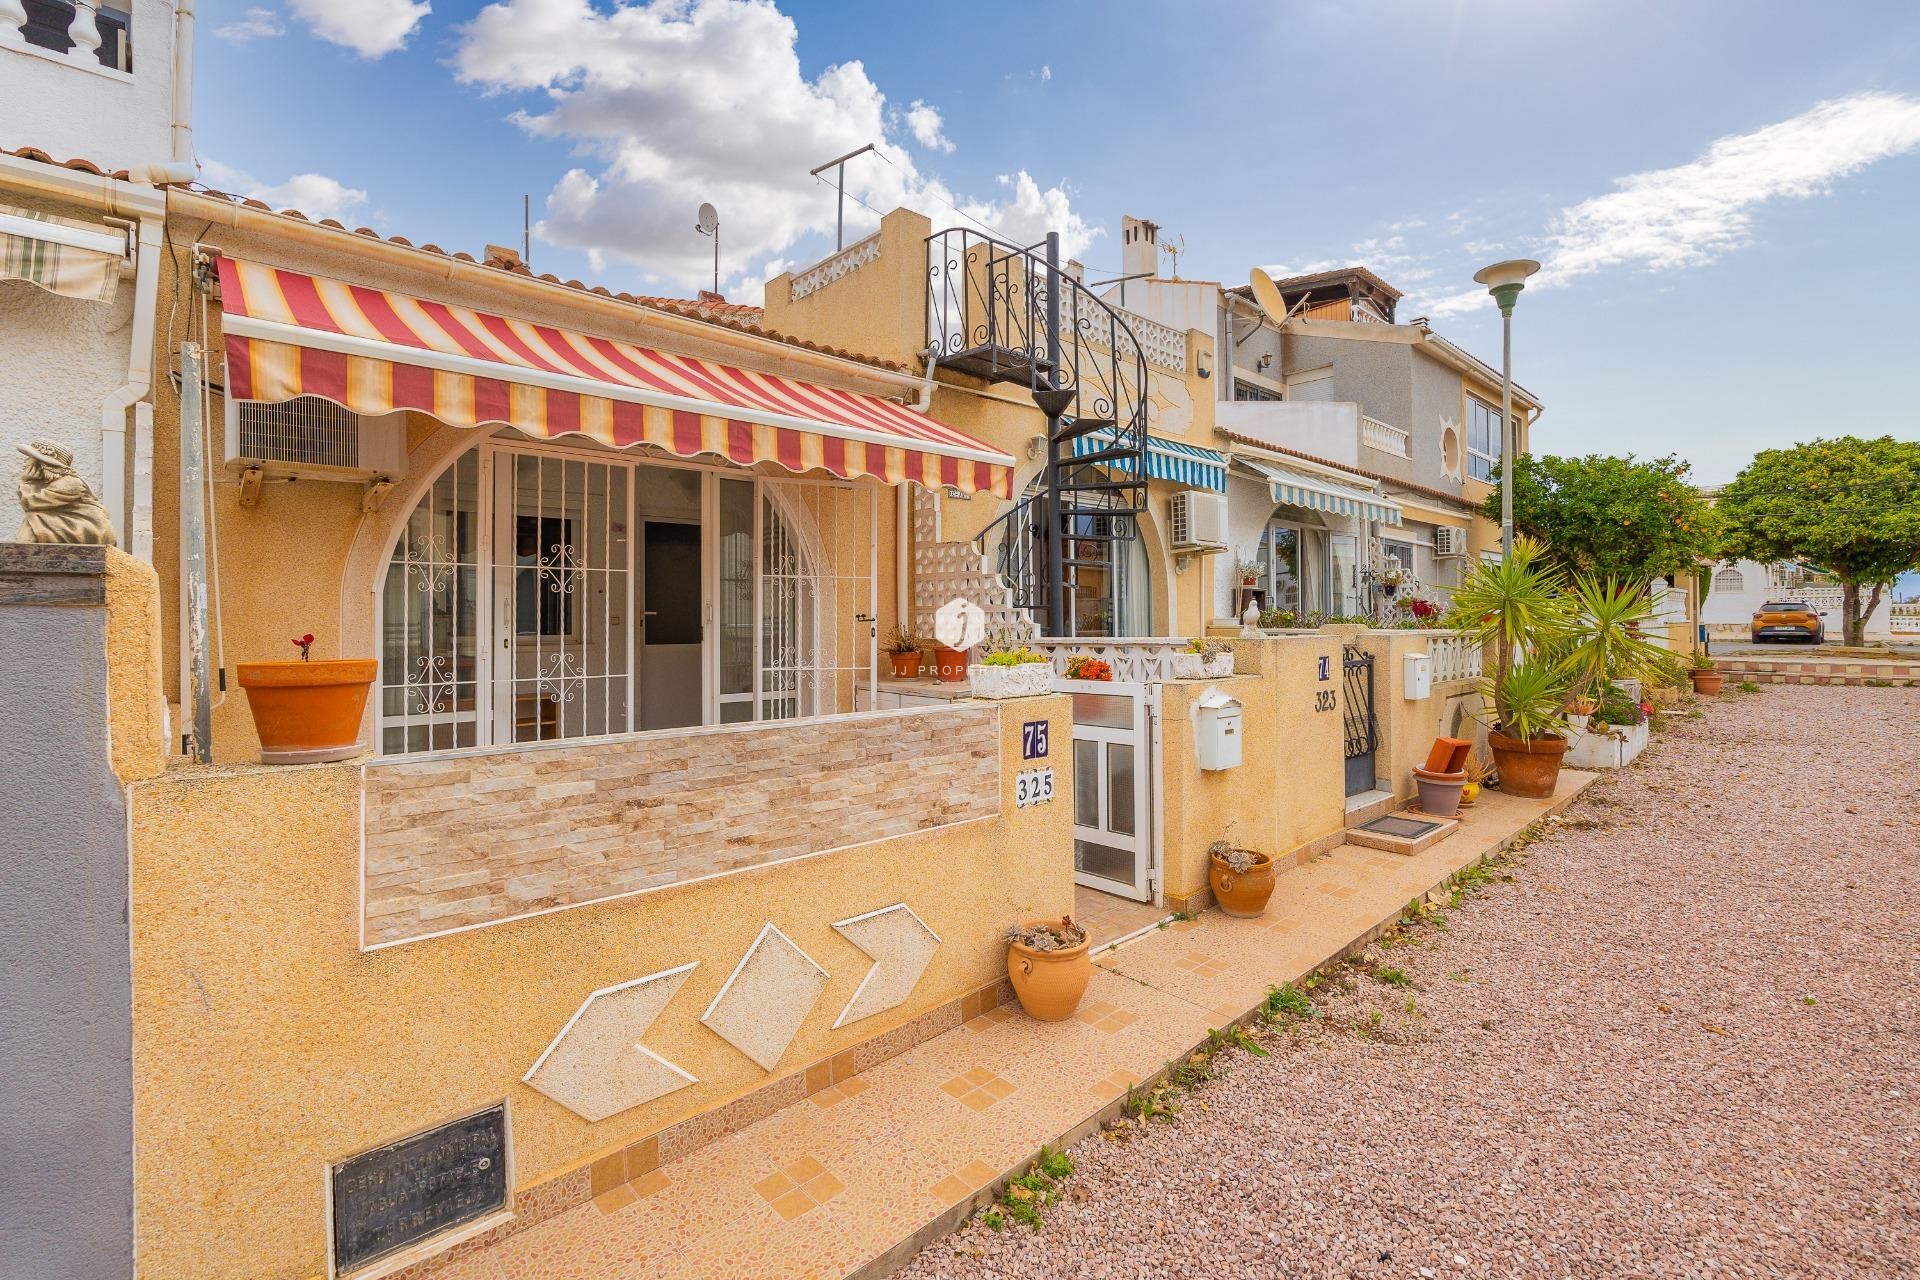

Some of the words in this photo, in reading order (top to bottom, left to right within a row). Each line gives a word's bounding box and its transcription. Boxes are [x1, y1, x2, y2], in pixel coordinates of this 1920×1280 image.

[1319, 659, 1329, 679] 74
[1315, 690, 1336, 712] 323
[1024, 723, 1047, 756] 75
[1018, 773, 1053, 801] 325
